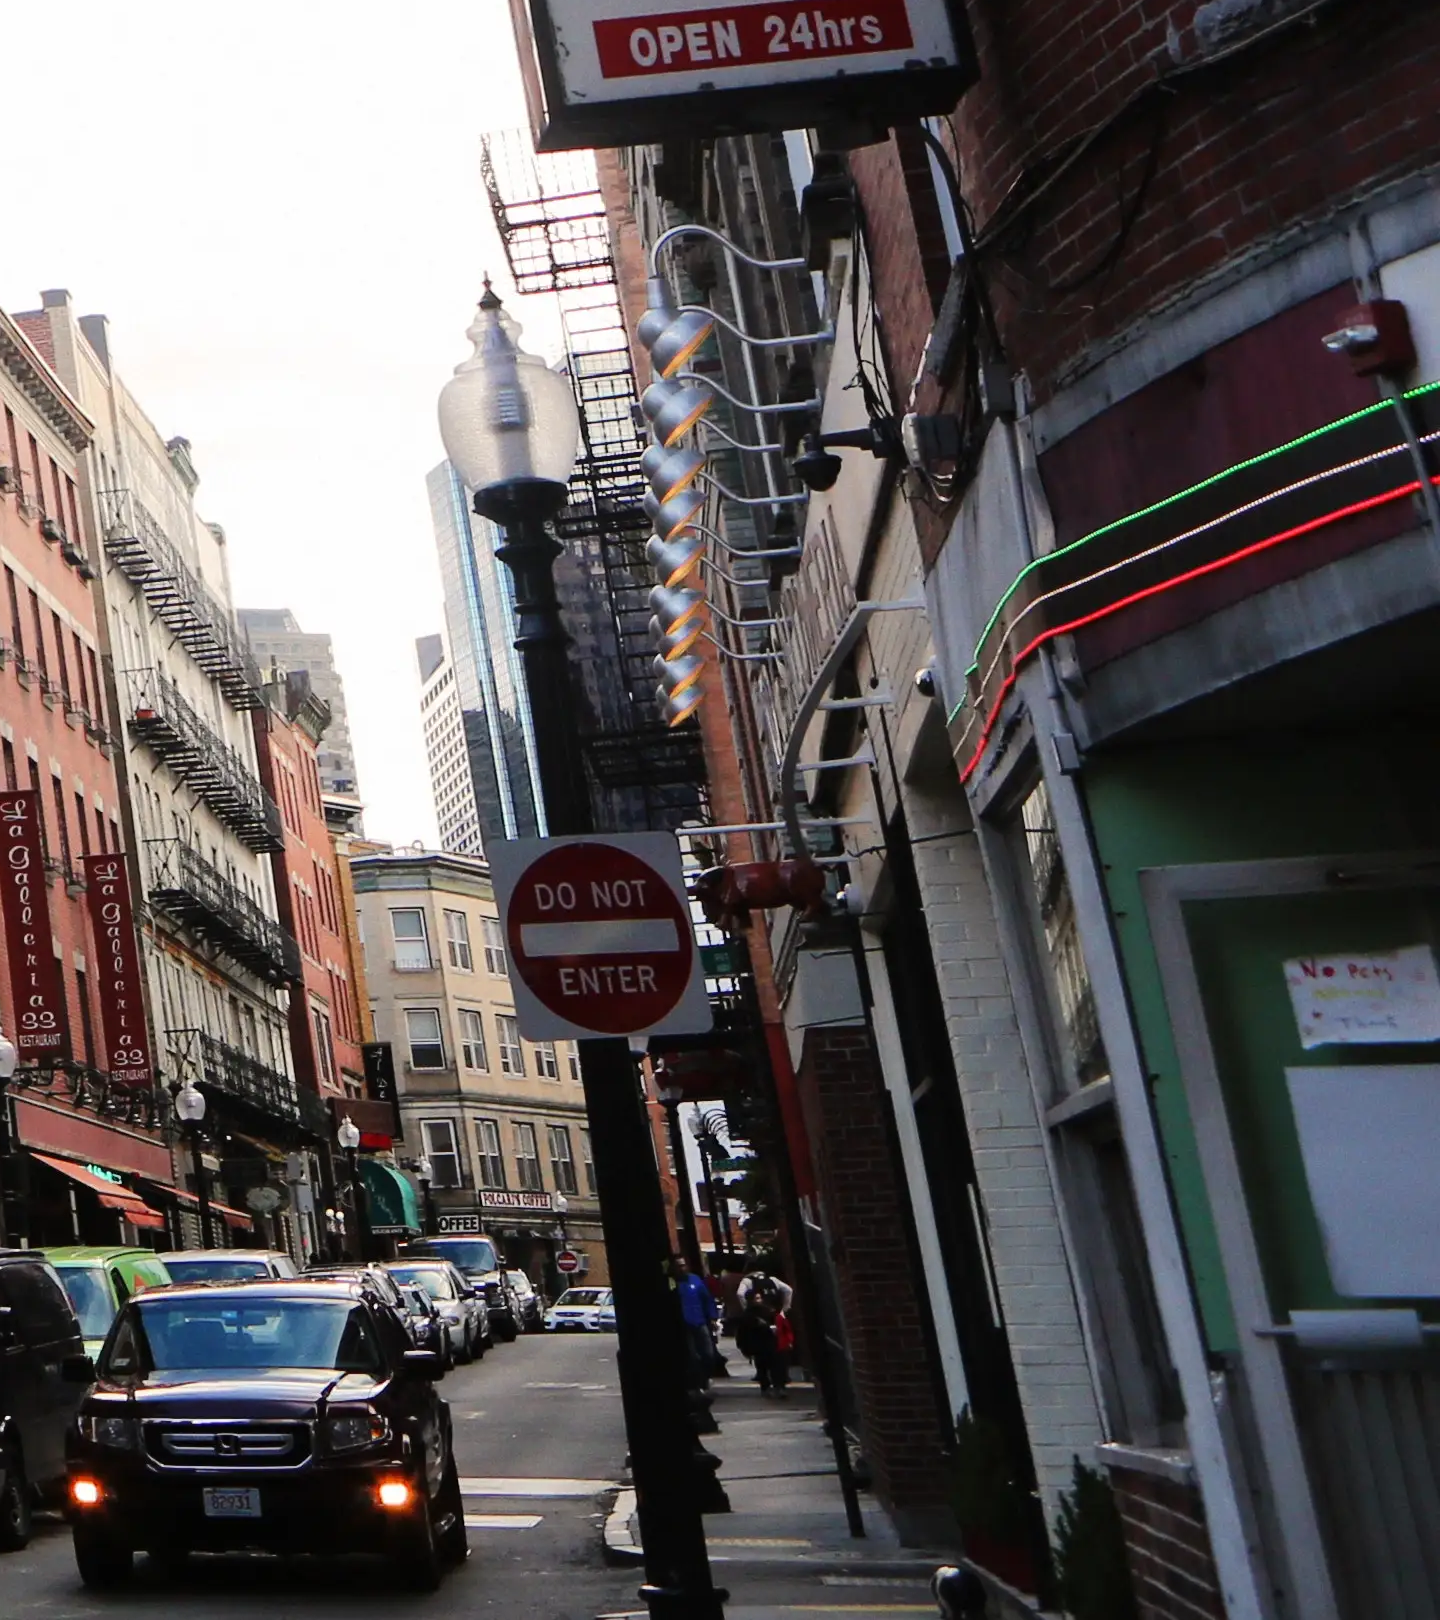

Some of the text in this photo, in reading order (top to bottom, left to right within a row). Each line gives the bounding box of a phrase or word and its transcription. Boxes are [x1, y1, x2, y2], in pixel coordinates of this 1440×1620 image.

[629, 7, 883, 67] OPEN 24hrs
[0, 799, 45, 1008] La Galleria
[534, 880, 647, 910] DO NOT
[93, 861, 132, 1046] La Galleria
[558, 965, 658, 996] ENTER
[21, 1011, 57, 1030] 33
[113, 1050, 145, 1066] 33
[439, 1217, 478, 1231] OFFEE
